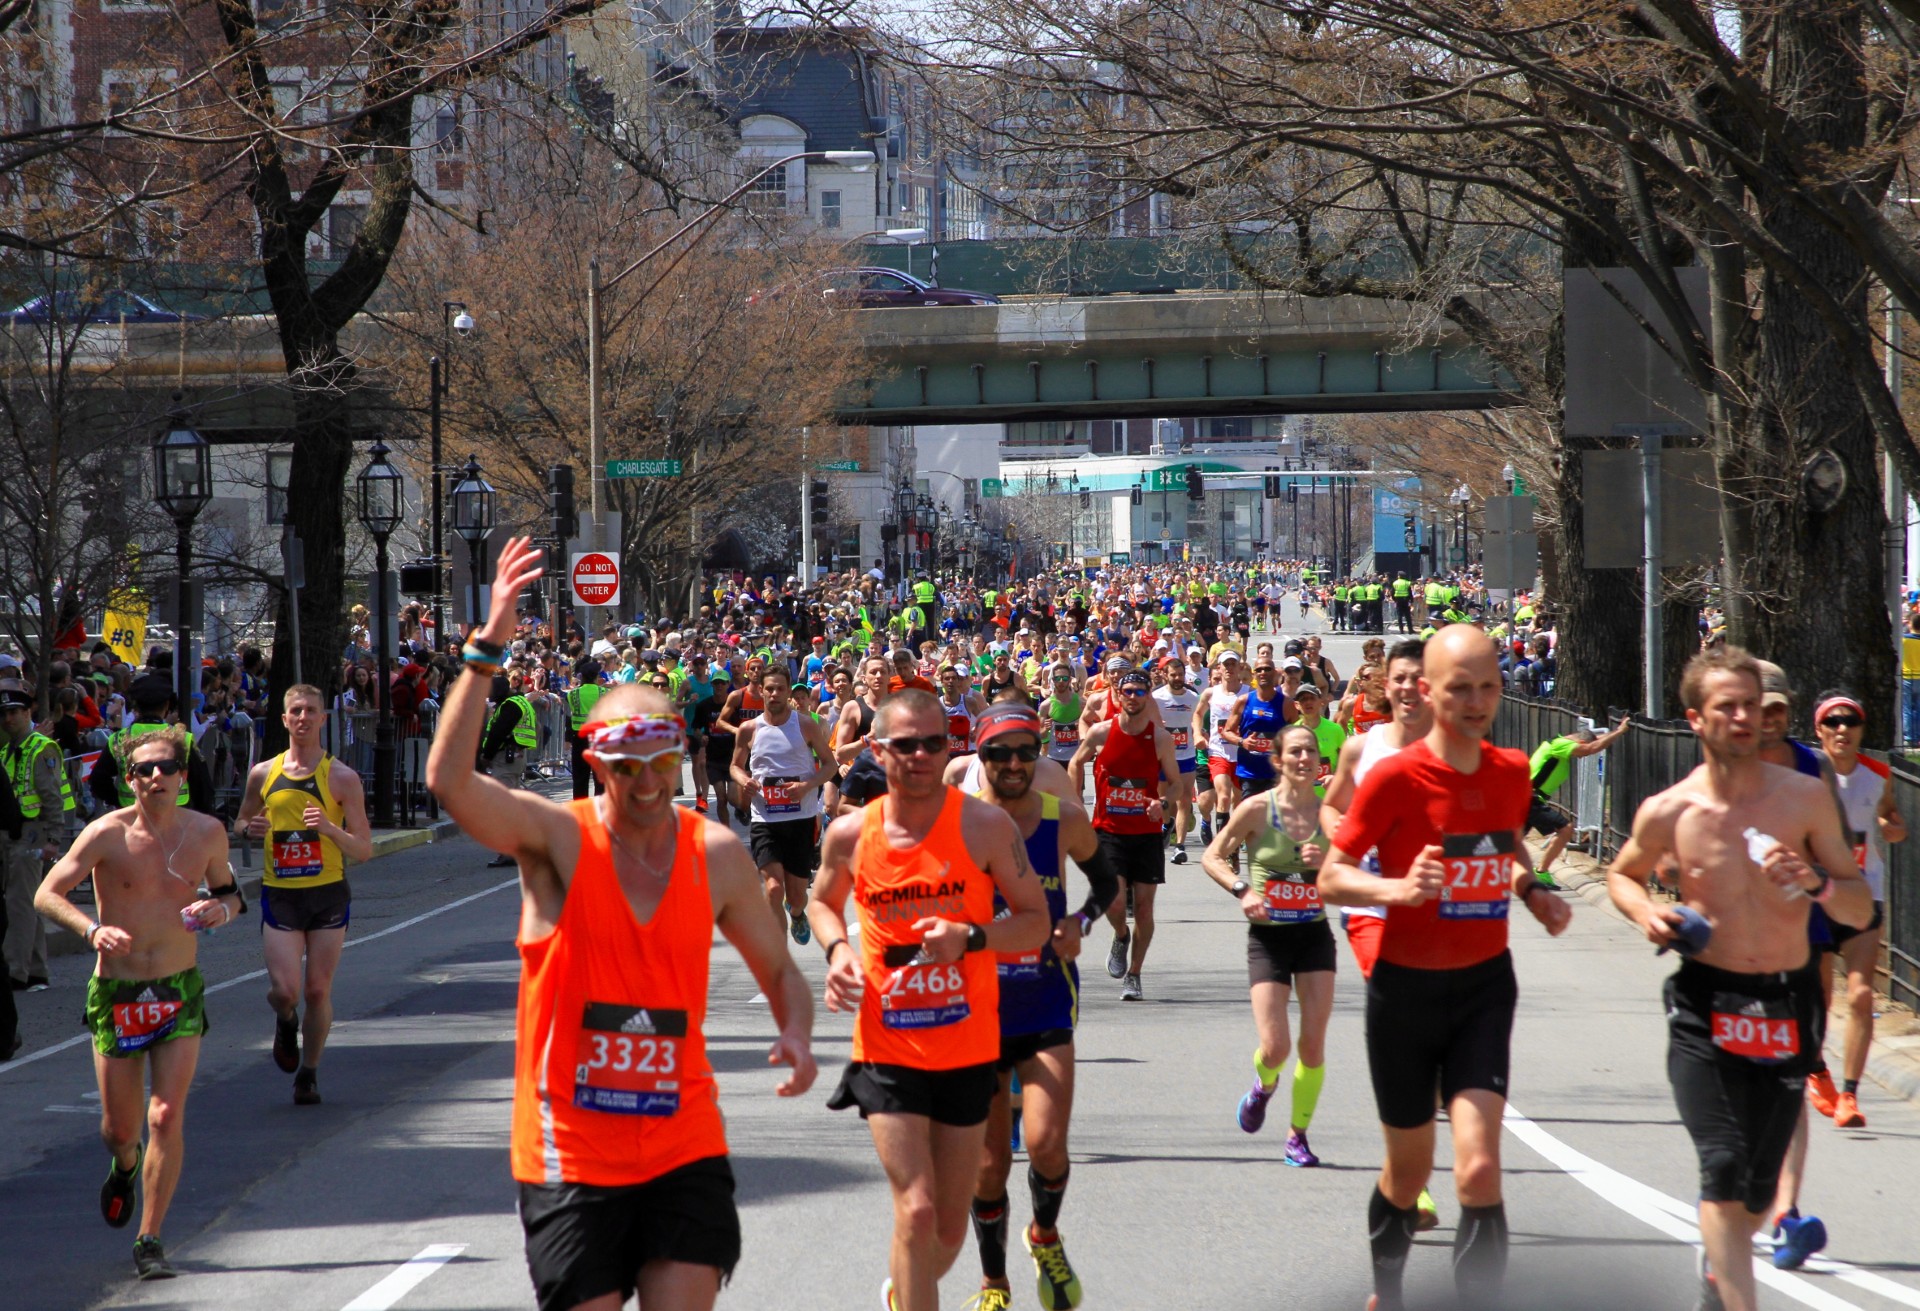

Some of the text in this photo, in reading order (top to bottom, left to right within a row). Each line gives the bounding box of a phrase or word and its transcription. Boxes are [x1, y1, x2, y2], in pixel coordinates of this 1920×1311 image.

[617, 462, 668, 474] CHARLESGATE
[579, 563, 612, 572] DO NOT
[582, 586, 609, 595] ENTER
[111, 628, 135, 648] #8
[1110, 789, 1144, 802] 4426
[281, 844, 312, 859] 753
[1268, 883, 1319, 900] 4890
[876, 895, 964, 923] UNNING
[889, 966, 963, 996] 2468
[1718, 1017, 1792, 1048] 3014
[587, 1034, 676, 1074] 3323
